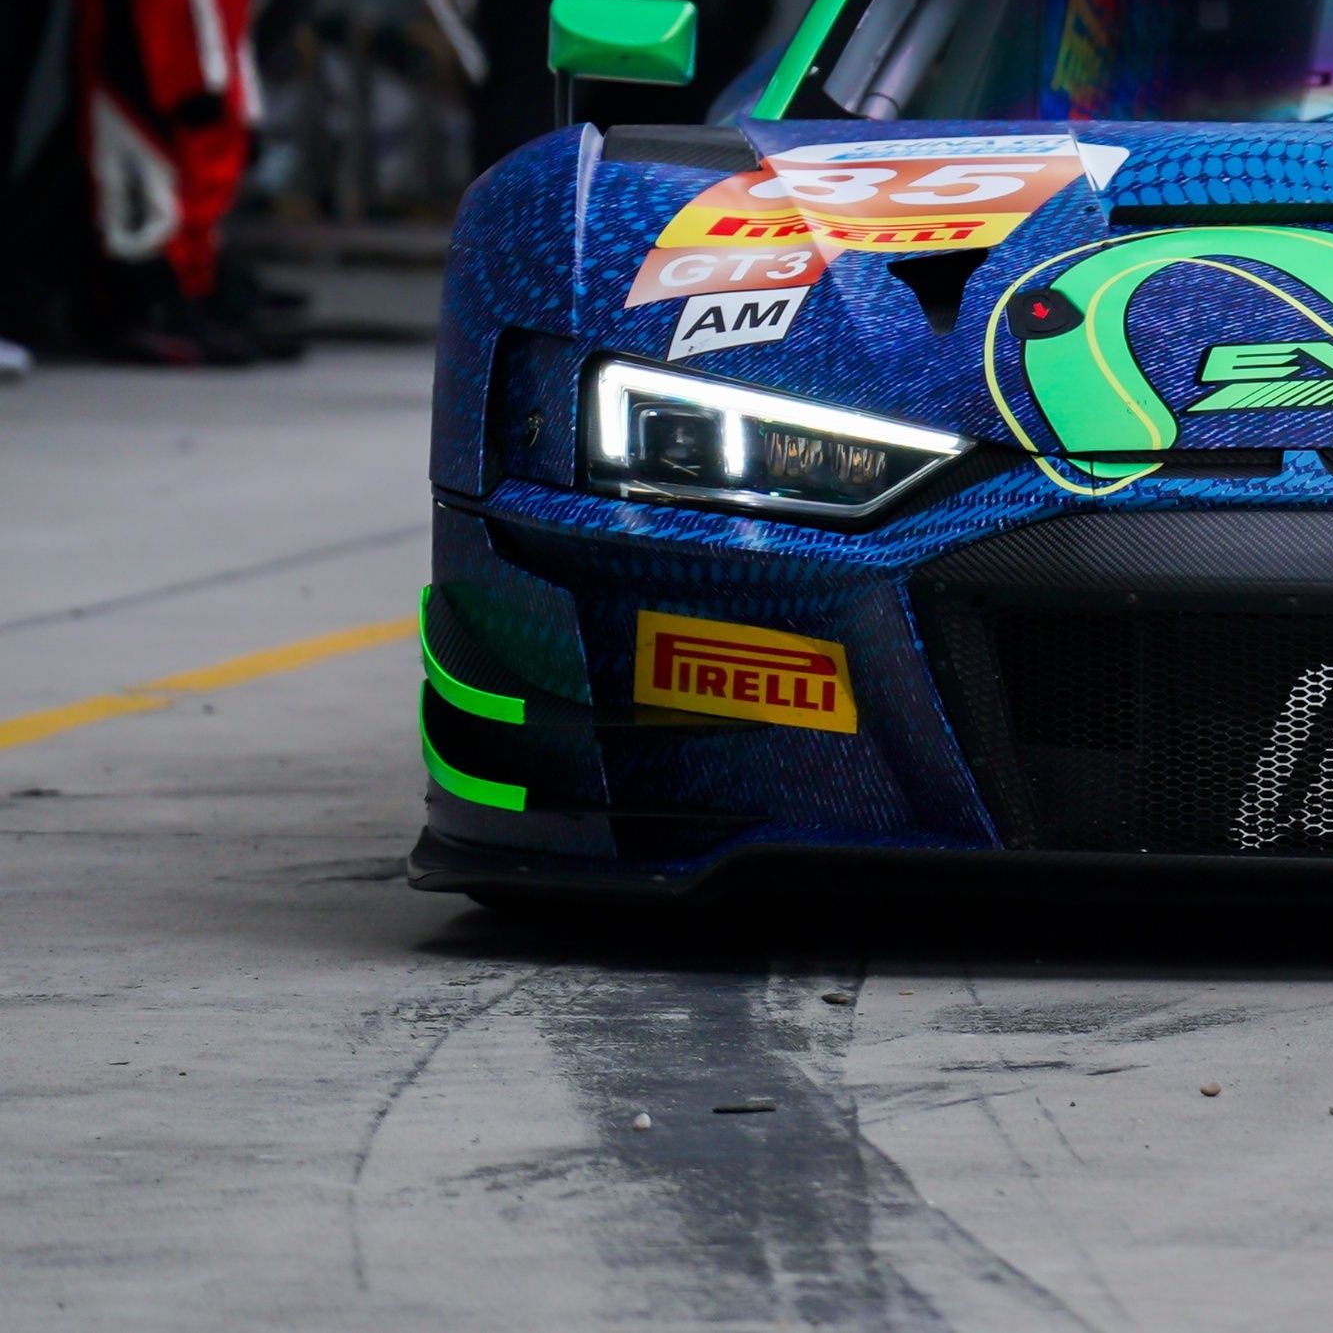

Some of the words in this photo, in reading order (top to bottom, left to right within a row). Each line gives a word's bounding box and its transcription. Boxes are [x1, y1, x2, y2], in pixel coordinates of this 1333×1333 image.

[748, 164, 1045, 205] 85
[706, 217, 986, 243] PIRELLI
[659, 250, 813, 286] GT3
[682, 299, 791, 340] AM
[653, 631, 838, 712] PIRELLI
